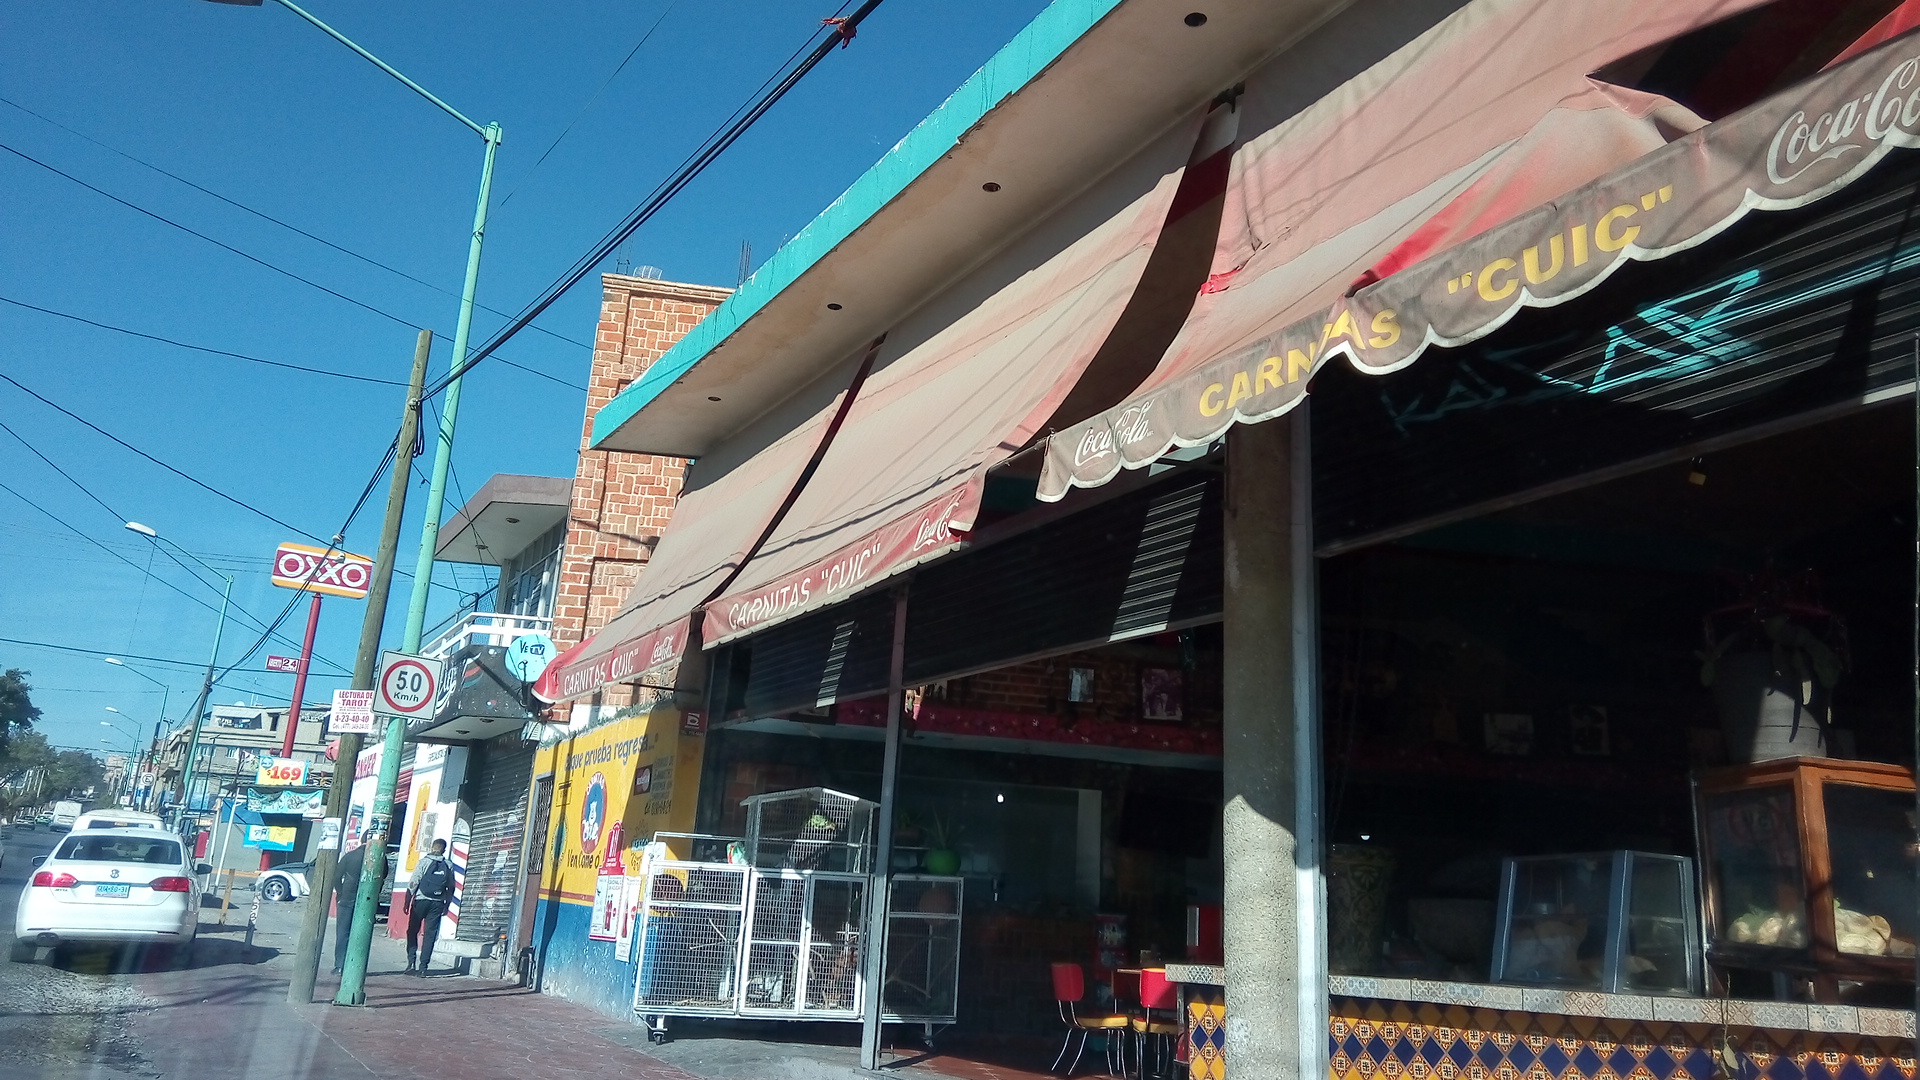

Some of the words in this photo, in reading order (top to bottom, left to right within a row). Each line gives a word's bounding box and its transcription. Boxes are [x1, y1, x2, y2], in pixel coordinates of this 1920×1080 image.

[1199, 308, 1401, 417] CARNAS
[1447, 184, 1673, 301] "CUIC"
[278, 552, 367, 588] OXXO
[728, 577, 811, 630] CARNITAS
[821, 543, 881, 595] "CUIC"
[282, 658, 297, 667] 24
[396, 670, 422, 692] 50
[563, 662, 606, 697] CARNITAS
[338, 690, 365, 699] LECTURA
[365, 691, 374, 699] DE
[341, 699, 369, 707] TAROT
[393, 691, 419, 702] Km/h
[265, 765, 302, 780] $169
